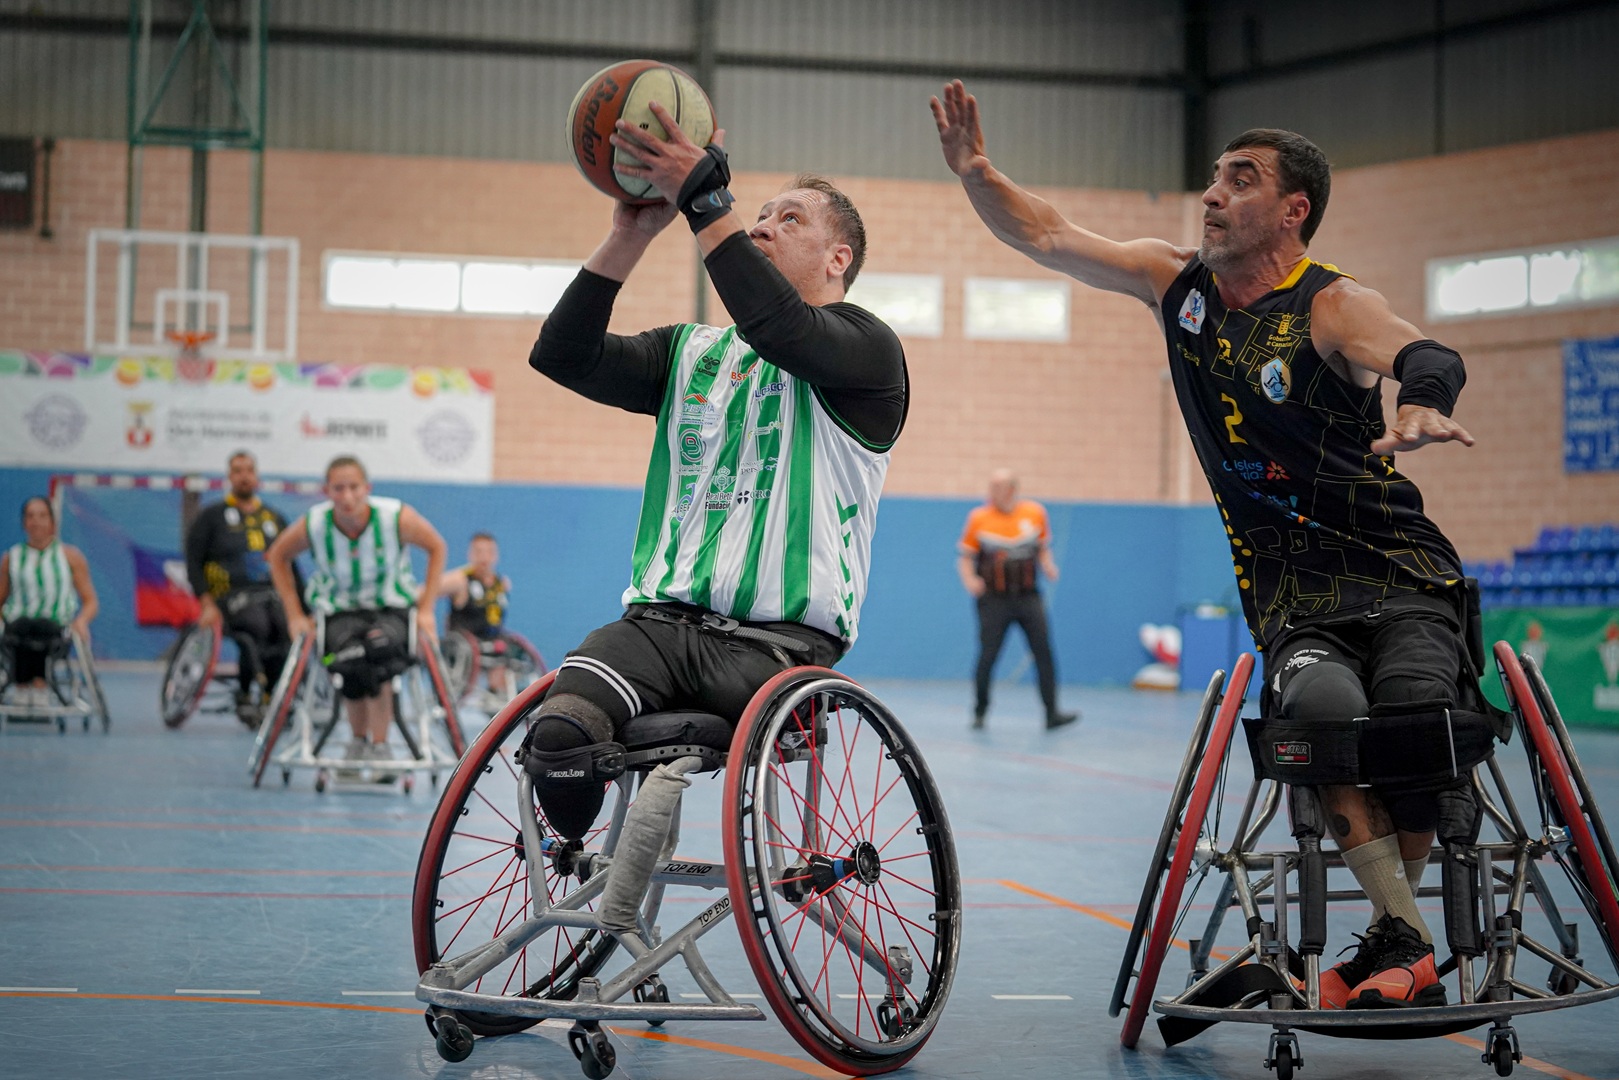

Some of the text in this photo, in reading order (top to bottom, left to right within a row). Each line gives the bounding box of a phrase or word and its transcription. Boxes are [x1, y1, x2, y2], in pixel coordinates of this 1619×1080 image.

[1221, 392, 1248, 445] 2
[705, 492, 733, 500] Real Beti
[663, 863, 713, 874] TOP END
[698, 897, 730, 926] TOP END
